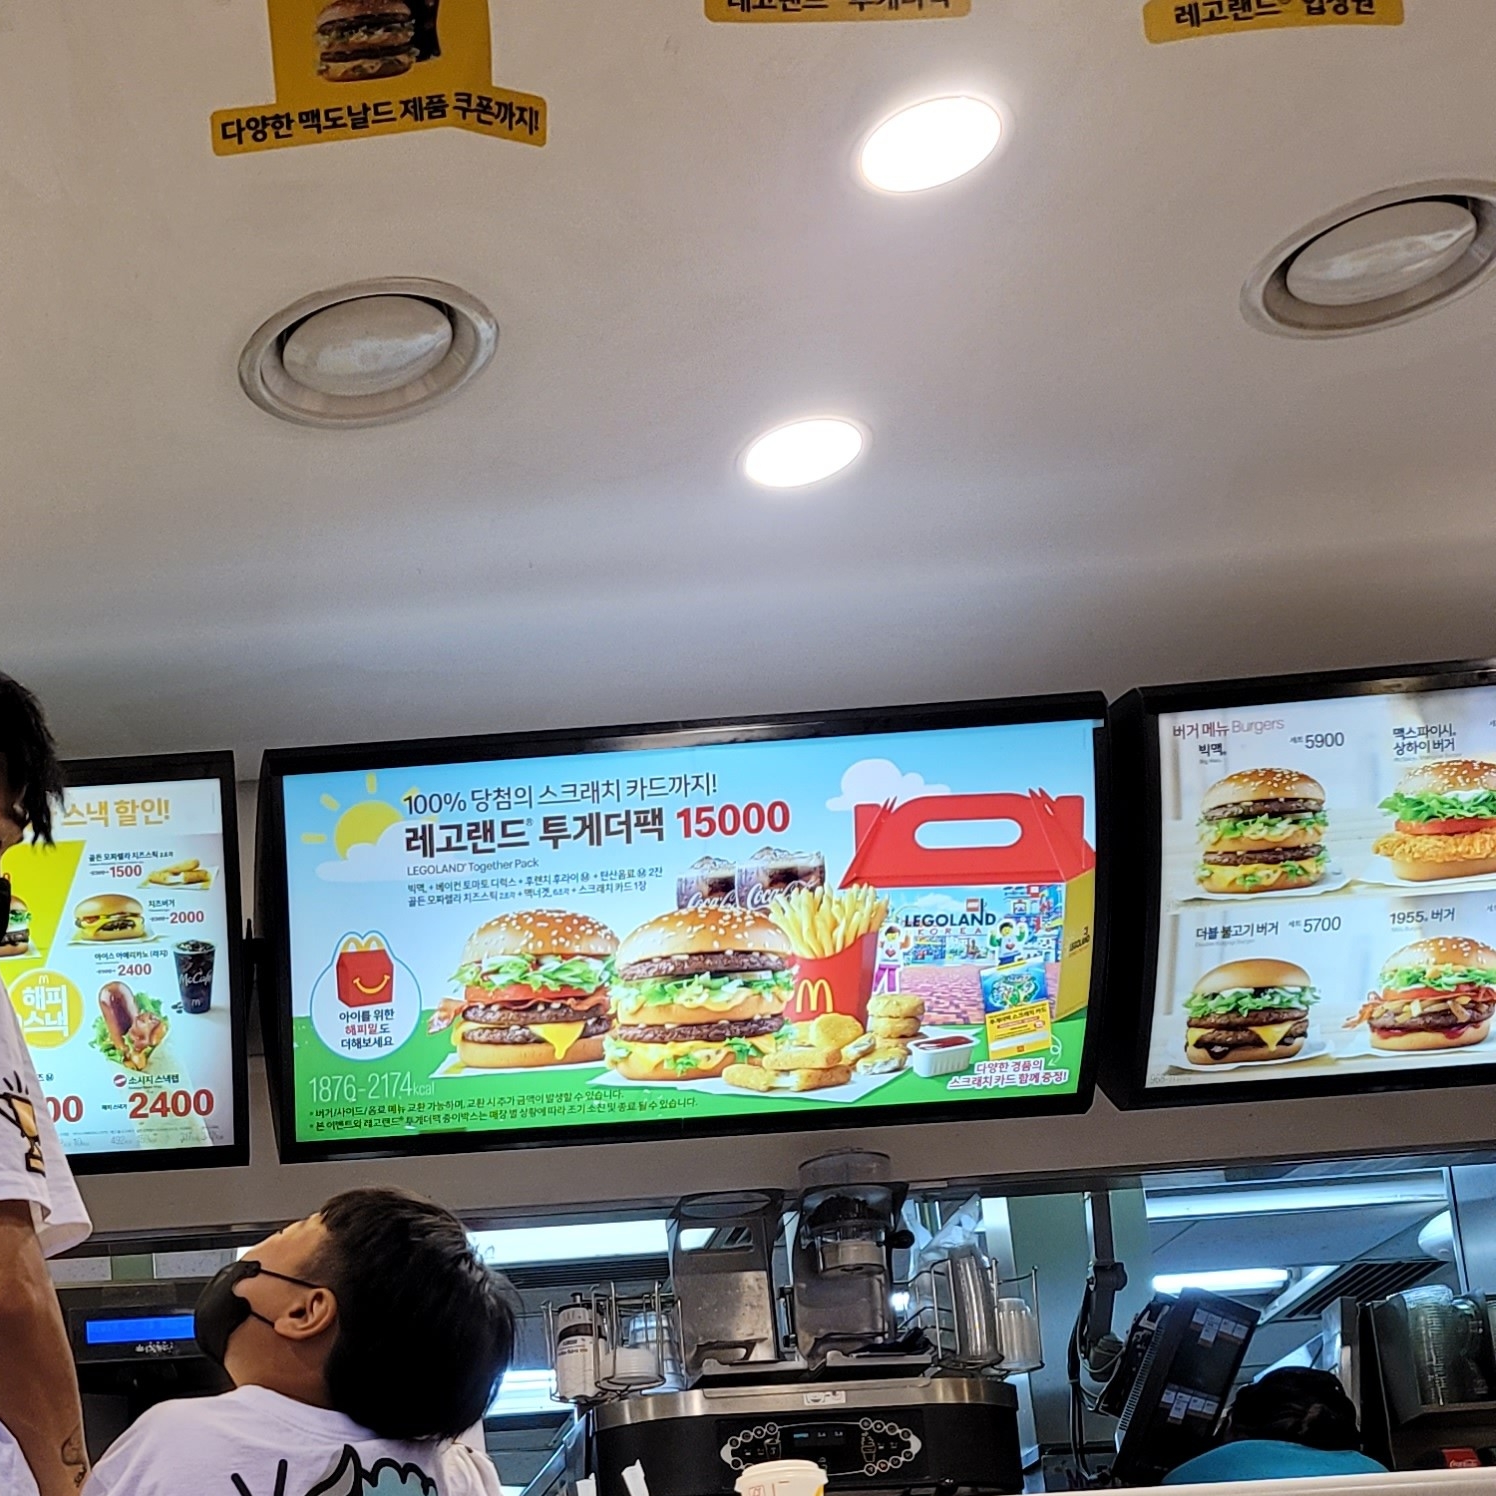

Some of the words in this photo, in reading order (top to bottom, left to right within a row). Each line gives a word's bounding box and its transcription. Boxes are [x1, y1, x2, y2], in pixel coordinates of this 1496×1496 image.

[220, 112, 295, 145] 다양한
[298, 101, 397, 134] 맥도날드
[400, 94, 449, 122] 제품
[453, 92, 540, 135] 쿠폰까지!
[1172, 723, 1199, 740] 버거
[1201, 721, 1230, 738] 메뉴
[1231, 719, 1285, 735] Burgers
[1305, 731, 1345, 749] 5900
[1392, 739, 1431, 756] 상하이
[1432, 737, 1456, 753] 버거
[403, 792, 466, 816] 100%
[470, 786, 534, 812] 당첨의
[537, 778, 622, 806] 스크래치
[625, 773, 718, 800] 카드까지!
[61, 800, 109, 828] 스낵
[114, 798, 170, 827] 할인!
[538, 805, 665, 850] 투게더팩
[676, 800, 791, 839] 15000
[109, 864, 142, 878] 1500
[468, 859, 513, 873] Together
[514, 859, 539, 868] Pack
[463, 879, 489, 890] 토마토
[490, 878, 516, 889] 디럭스
[552, 873, 579, 884] 후라이
[463, 891, 498, 902] 치즈스틱
[579, 884, 613, 895] 스크래치
[615, 883, 633, 893] 카드
[170, 911, 204, 923] 2000
[905, 899, 997, 928] LEGOLAND
[1431, 907, 1456, 923] 버거
[917, 926, 982, 936] KOREA
[1196, 926, 1218, 941] 더블
[1220, 922, 1255, 940] 불고기
[1256, 921, 1279, 937] 버거
[1303, 915, 1341, 934] 5700
[117, 963, 151, 976] 2400
[22, 984, 68, 1010] 해피
[339, 1009, 371, 1023] 아이를
[373, 1008, 394, 1021] 위한
[24, 1013, 70, 1037] 스낵
[341, 1037, 394, 1050] 더해보세요
[976, 1062, 1011, 1075] 다양한
[1012, 1060, 1043, 1073] 경품의
[128, 1074, 153, 1085] 소시지
[948, 1075, 993, 1088] 스크래치
[994, 1074, 1017, 1087] 카드
[1018, 1072, 1040, 1085] 함께
[1041, 1071, 1067, 1084] 증정!
[128, 1088, 215, 1119] 2400
